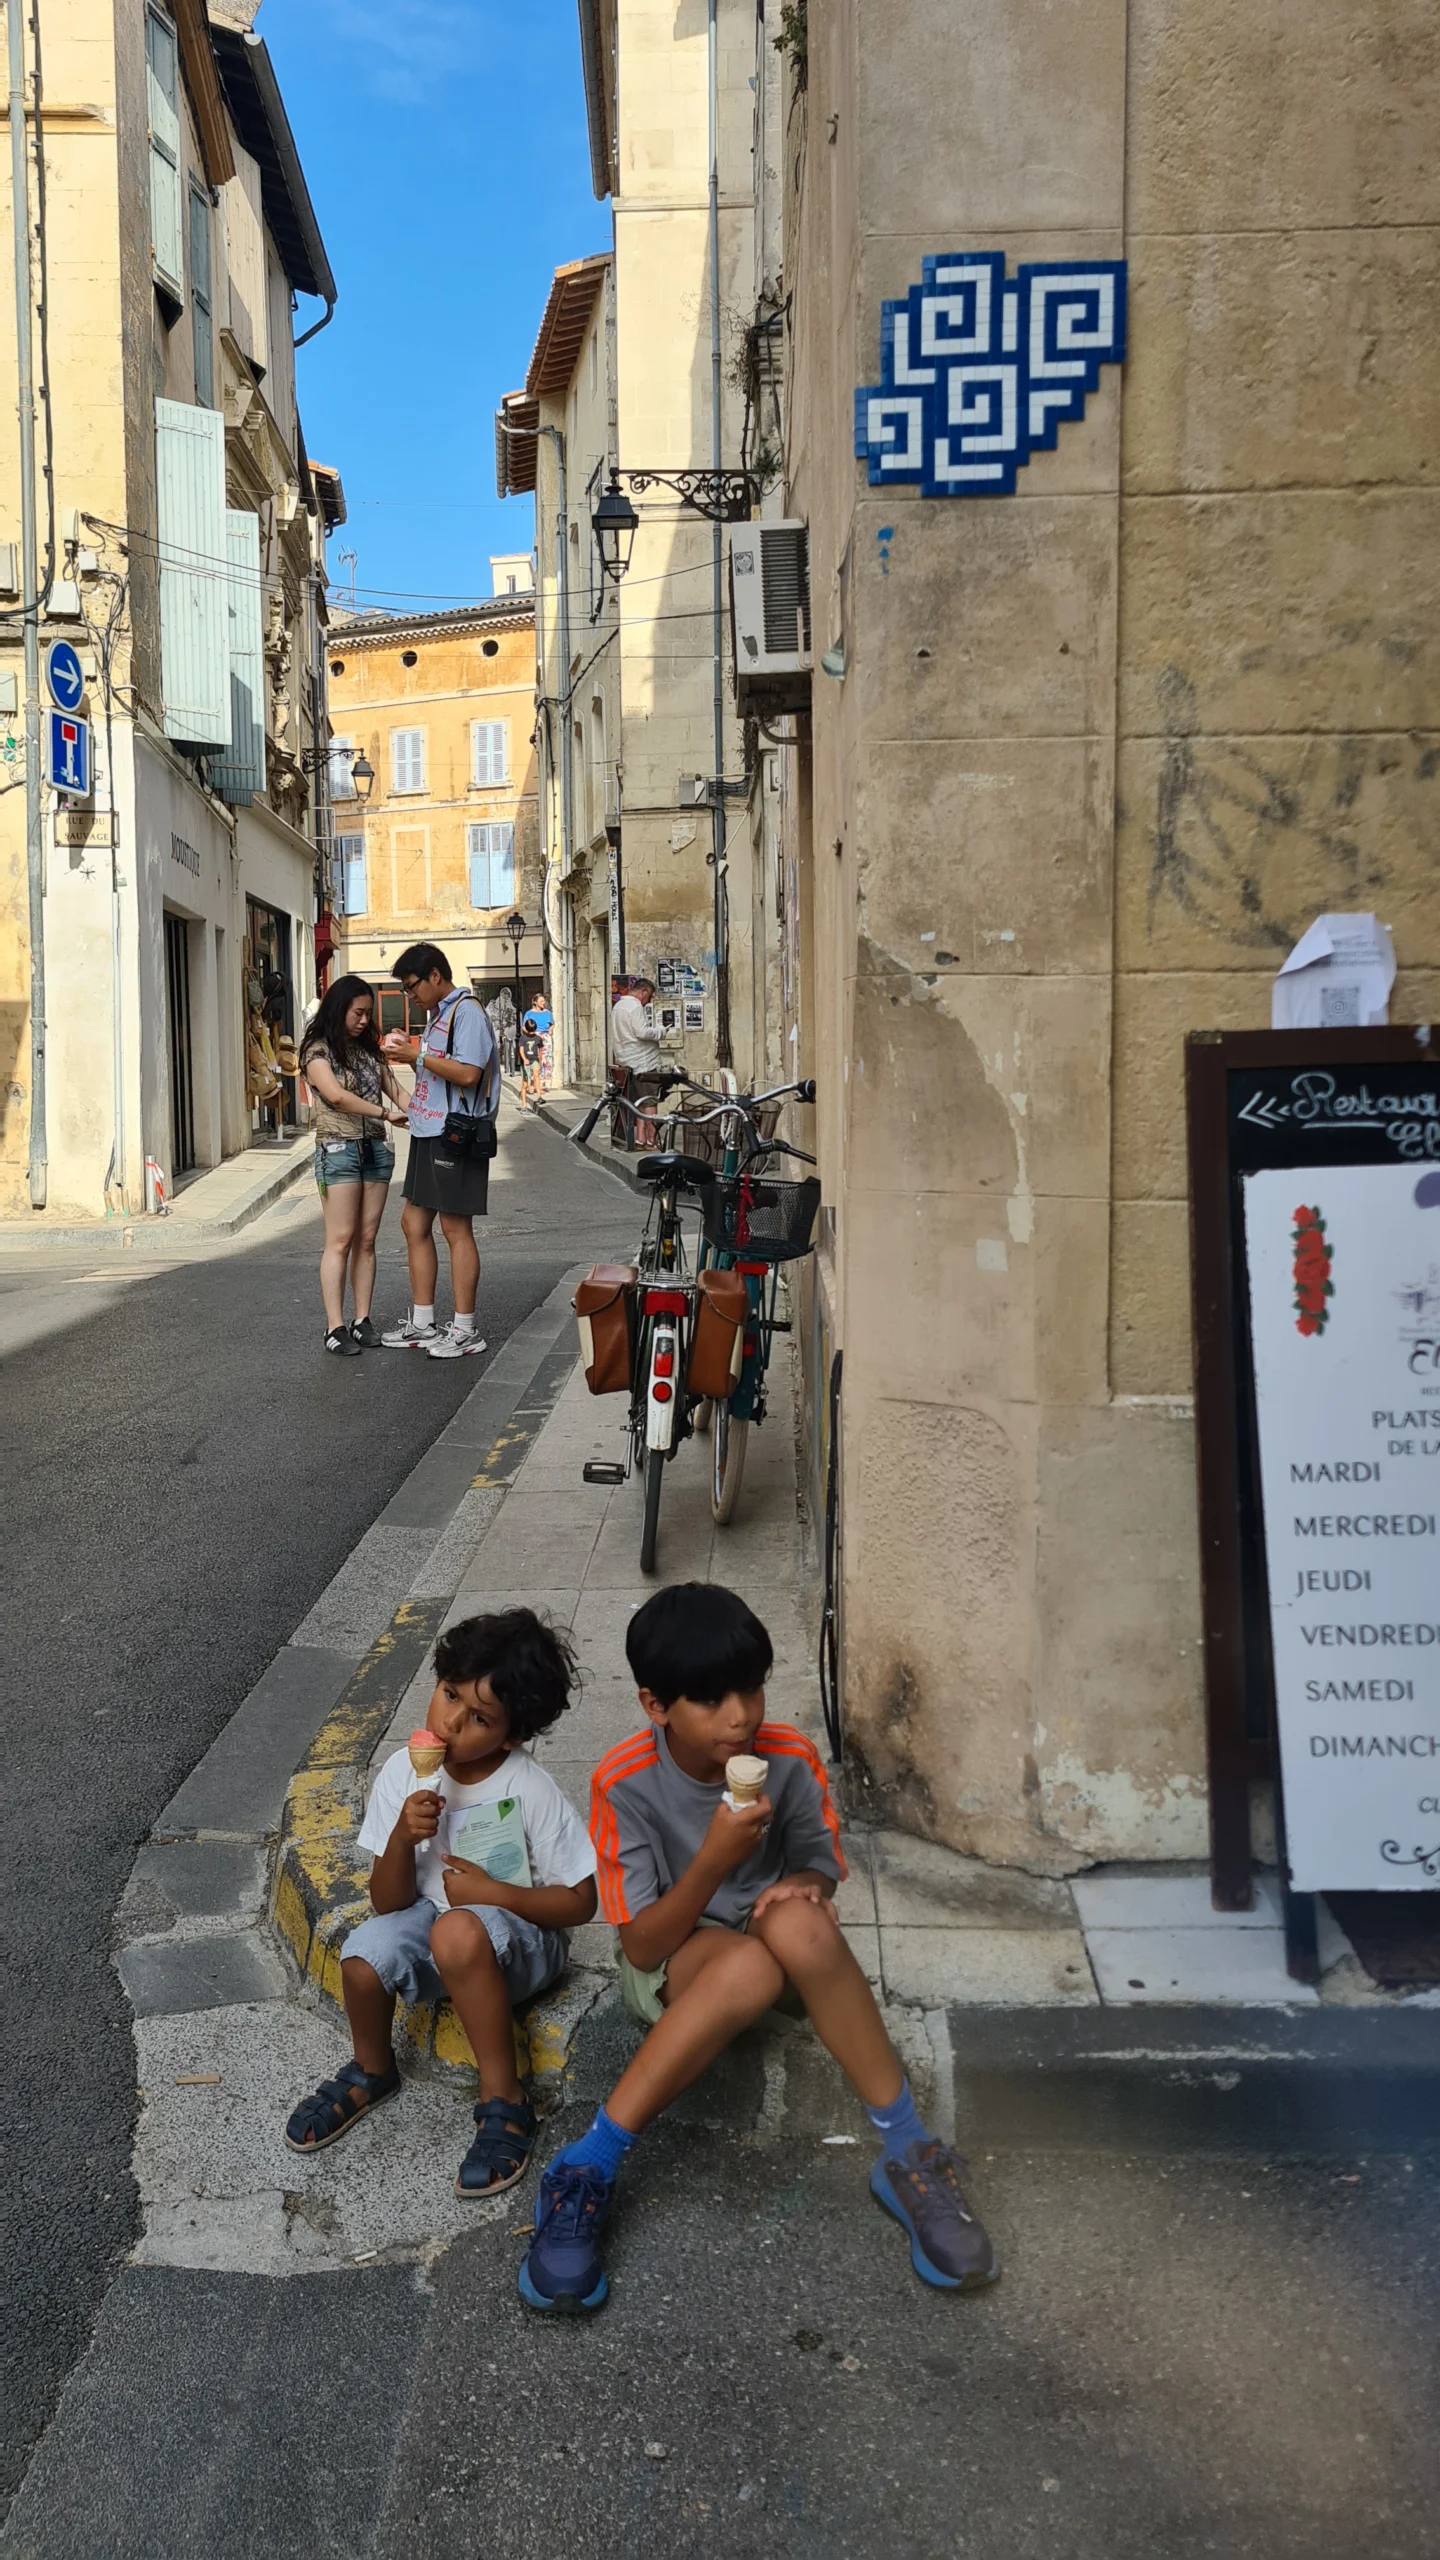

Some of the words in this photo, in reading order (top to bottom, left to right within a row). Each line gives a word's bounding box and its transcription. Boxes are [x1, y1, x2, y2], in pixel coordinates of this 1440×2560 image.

[66, 817, 84, 825] RUE
[92, 817, 105, 825] DU
[65, 833, 109, 841] SAUVAGE
[1372, 1410, 1440, 1429] PLATS
[1387, 1440, 1416, 1456] DE
[1290, 1461, 1381, 1484] MARDI
[1294, 1514, 1436, 1537] MERCREDI
[1294, 1569, 1372, 1599] JEUDI
[1305, 1679, 1414, 1702] SAMEDI
